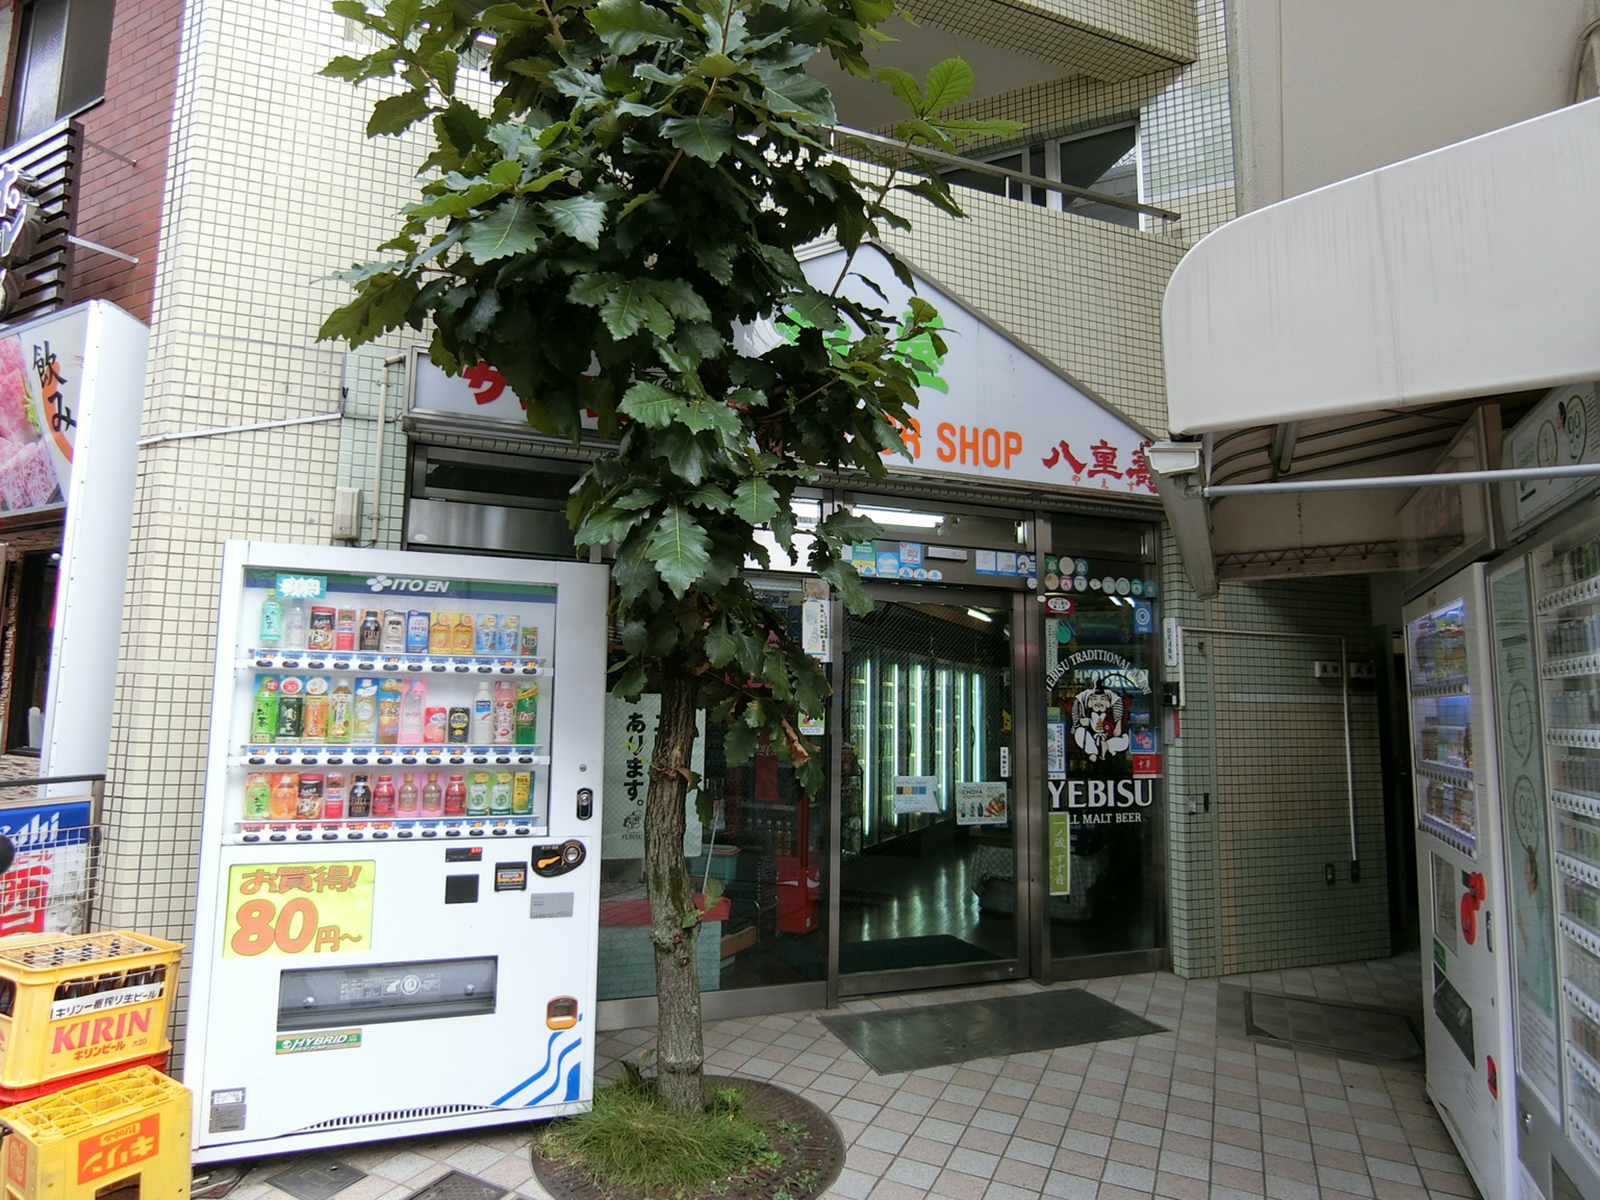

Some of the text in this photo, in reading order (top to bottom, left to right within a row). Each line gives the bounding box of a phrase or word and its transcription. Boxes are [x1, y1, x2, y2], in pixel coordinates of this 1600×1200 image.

[33, 340, 76, 432] 飲み
[936, 421, 1022, 470] SHOP
[391, 578, 450, 593] ITO EN
[1069, 649, 1130, 671] TRADITIONAL
[623, 712, 646, 807] あります。
[1048, 779, 1153, 809] YEBISU
[1082, 813, 1112, 824] MALT
[1115, 812, 1142, 823] BEER
[239, 865, 362, 895] お買得!
[55, 990, 157, 1018] キリン一番搾り生ビール
[51, 1007, 152, 1055] KIRIN
[289, 1034, 349, 1052] HYBRID
[73, 1040, 126, 1061] キリンビール
[81, 1134, 155, 1174] キリン
